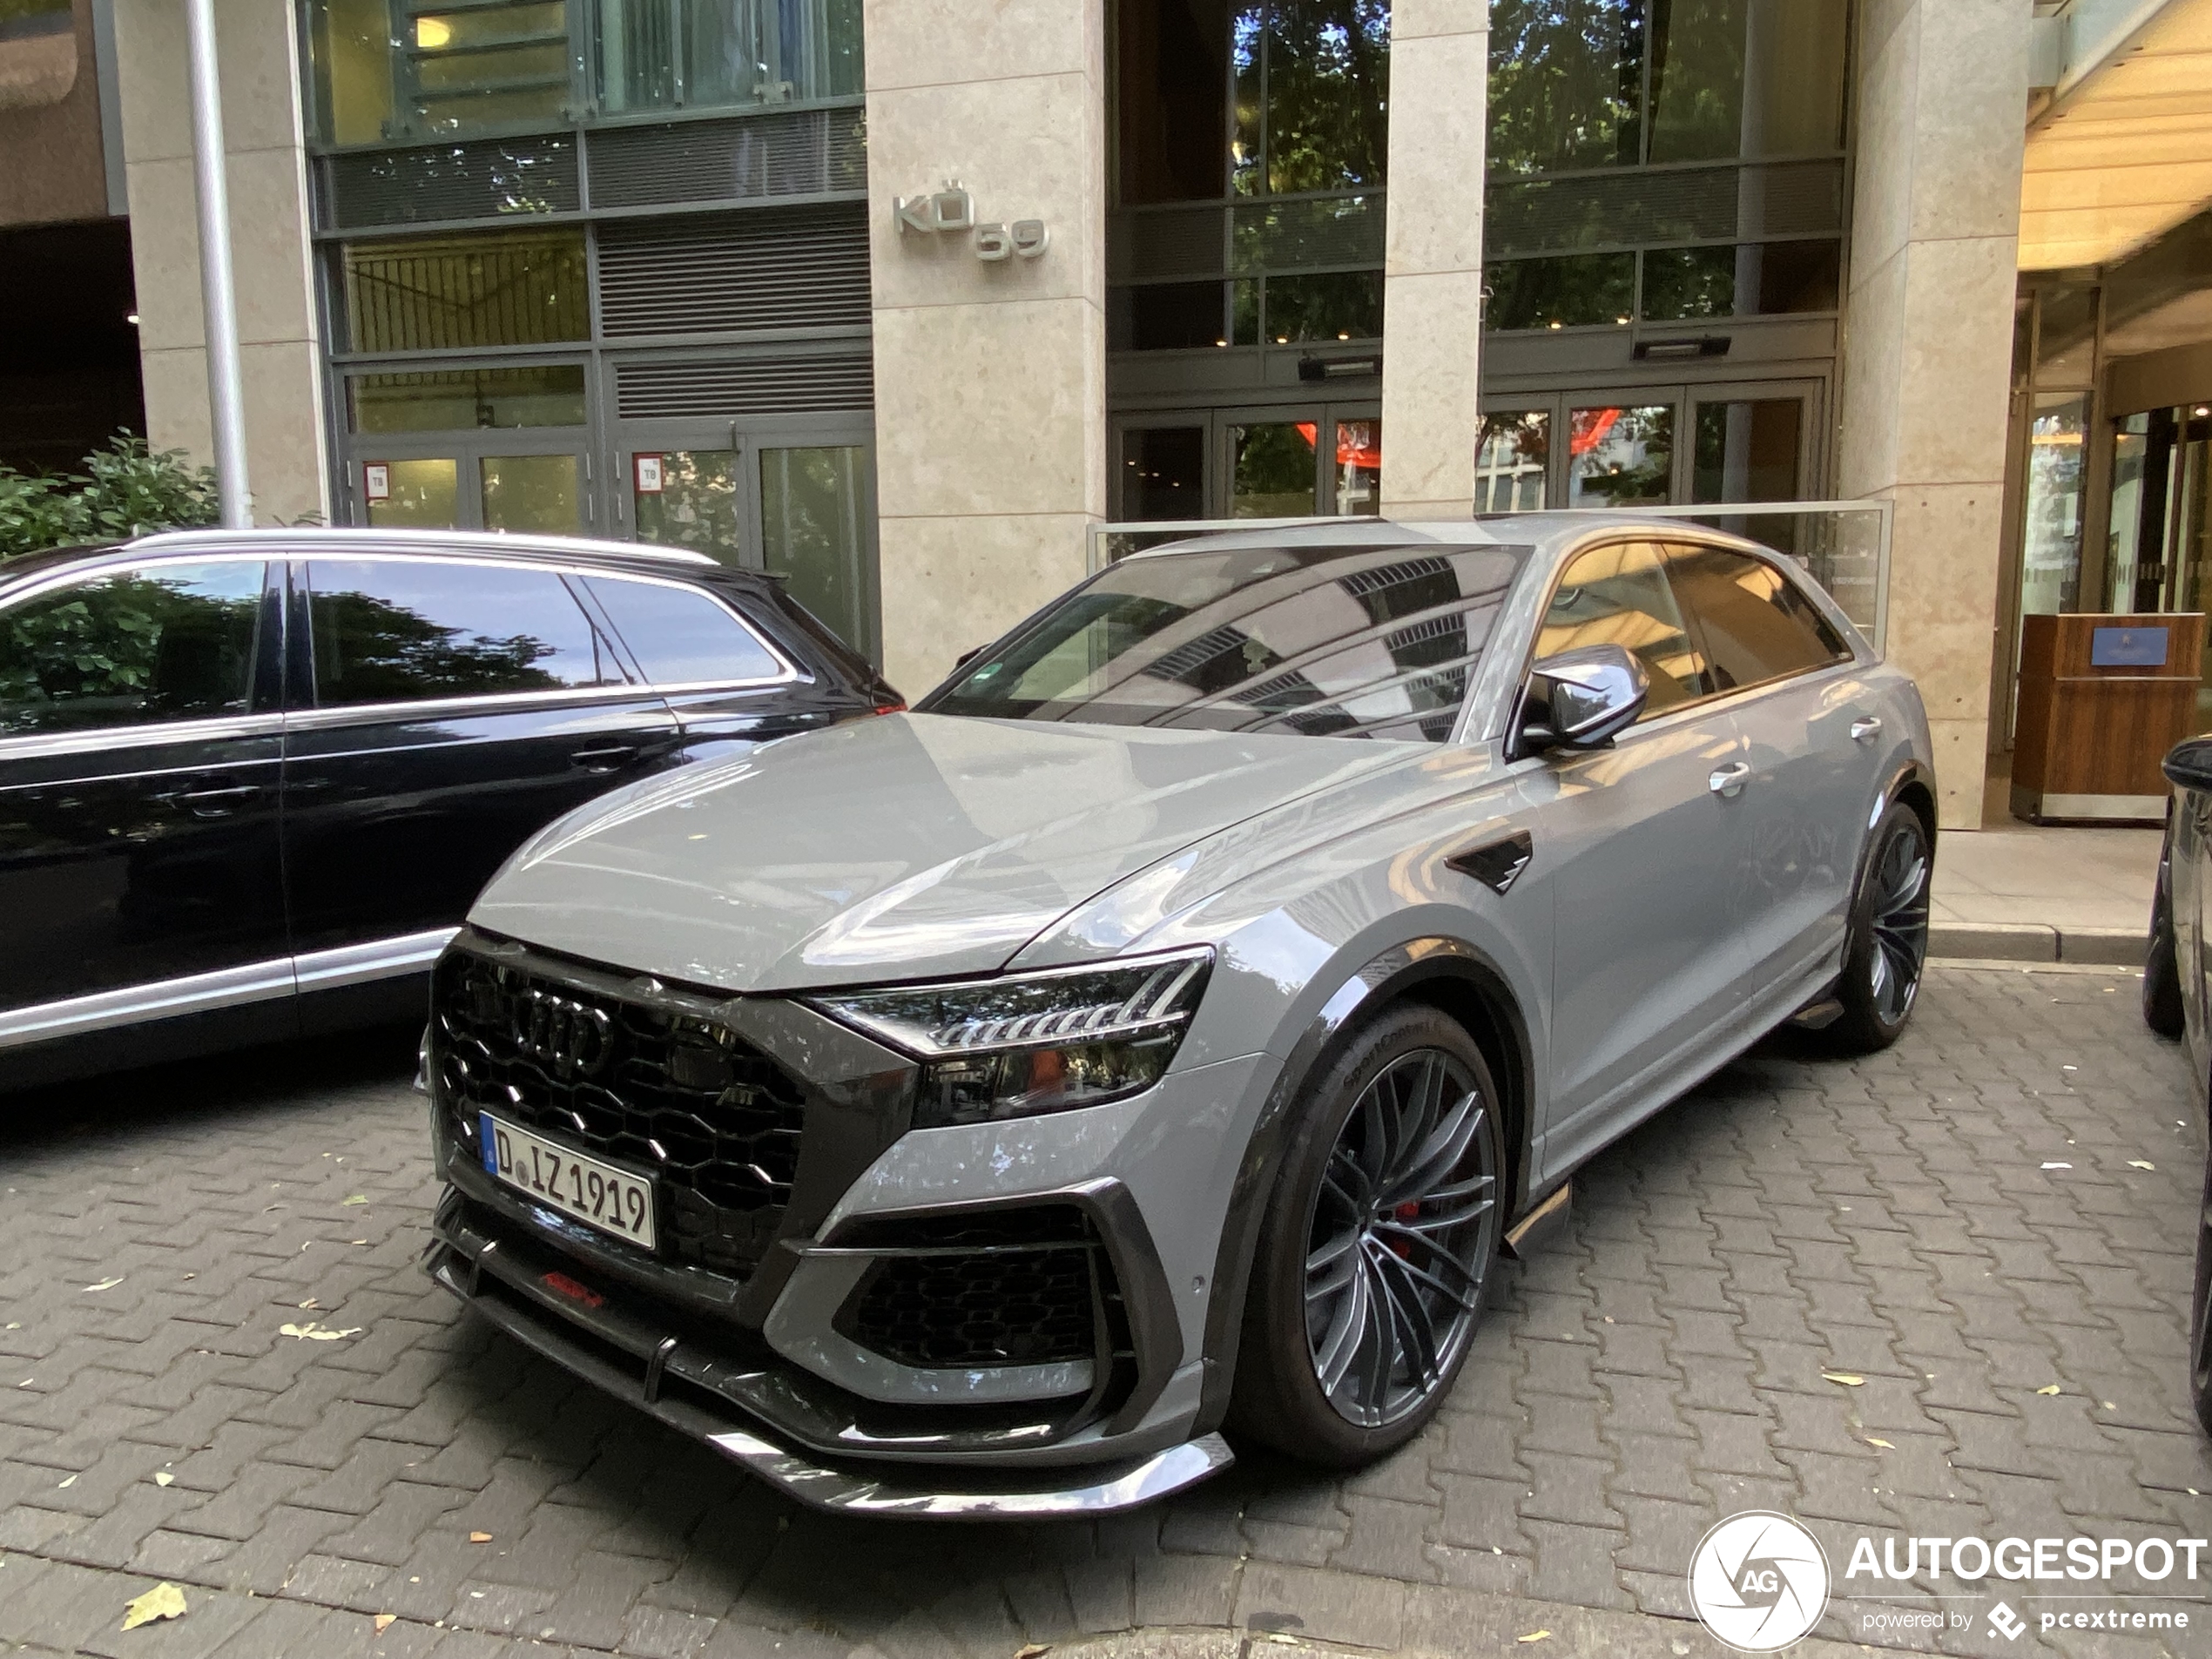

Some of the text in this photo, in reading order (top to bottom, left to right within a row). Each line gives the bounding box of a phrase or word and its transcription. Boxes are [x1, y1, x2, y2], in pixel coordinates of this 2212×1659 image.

[894, 179, 1050, 261] KÖ 59
[495, 1129, 512, 1175] D
[570, 1163, 645, 1233] 1919
